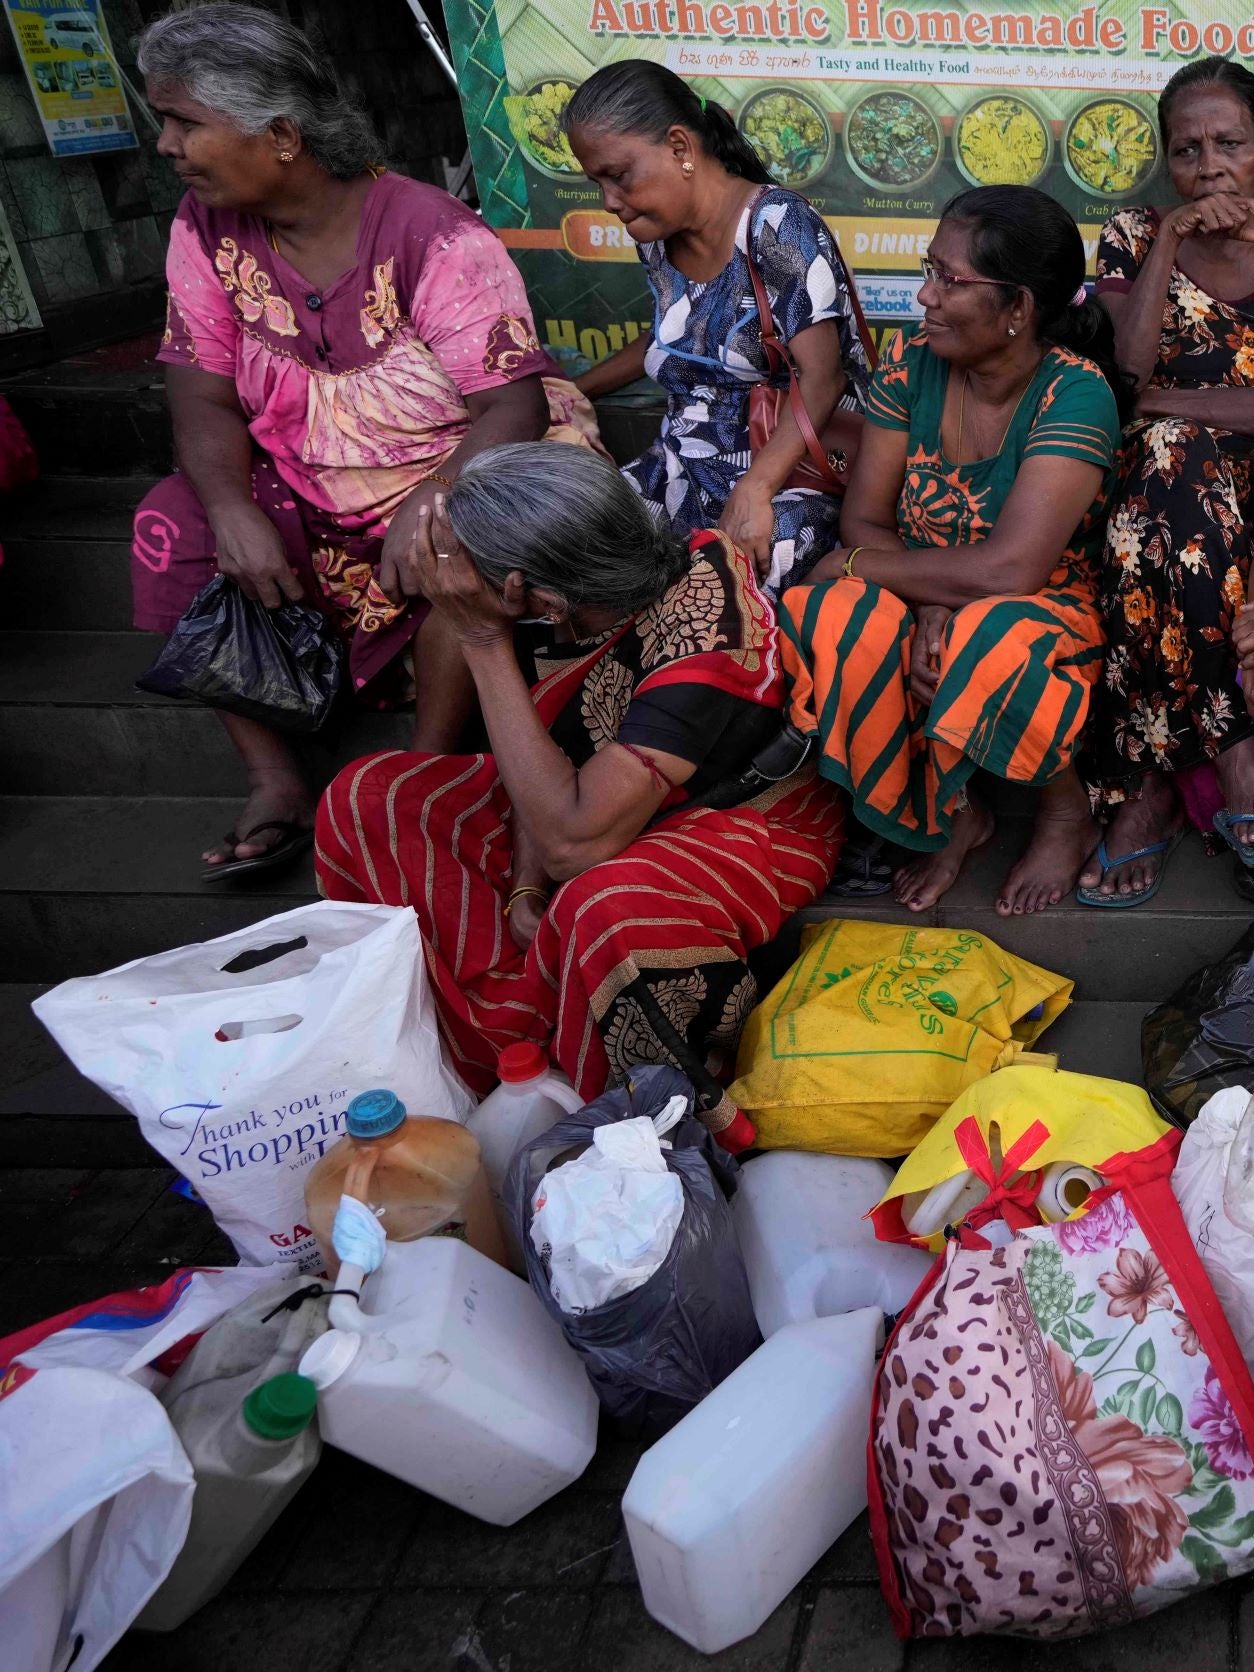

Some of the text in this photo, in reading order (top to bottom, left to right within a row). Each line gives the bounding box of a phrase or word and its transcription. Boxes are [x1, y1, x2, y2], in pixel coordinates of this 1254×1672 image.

[590, 0, 827, 38] Authentic
[846, 0, 1124, 50] Homemade
[816, 56, 970, 75] Tasty and Healthy Food
[555, 188, 600, 203] Buriyani
[863, 197, 934, 213] Mutton Curry
[1085, 203, 1109, 216] Crab
[854, 231, 935, 255] DINNE
[899, 289, 912, 297] on
[860, 296, 912, 312] cebook
[159, 1088, 349, 1157] Thank you for
[198, 1110, 350, 1178] Shoppin
[288, 1153, 316, 1172] with
